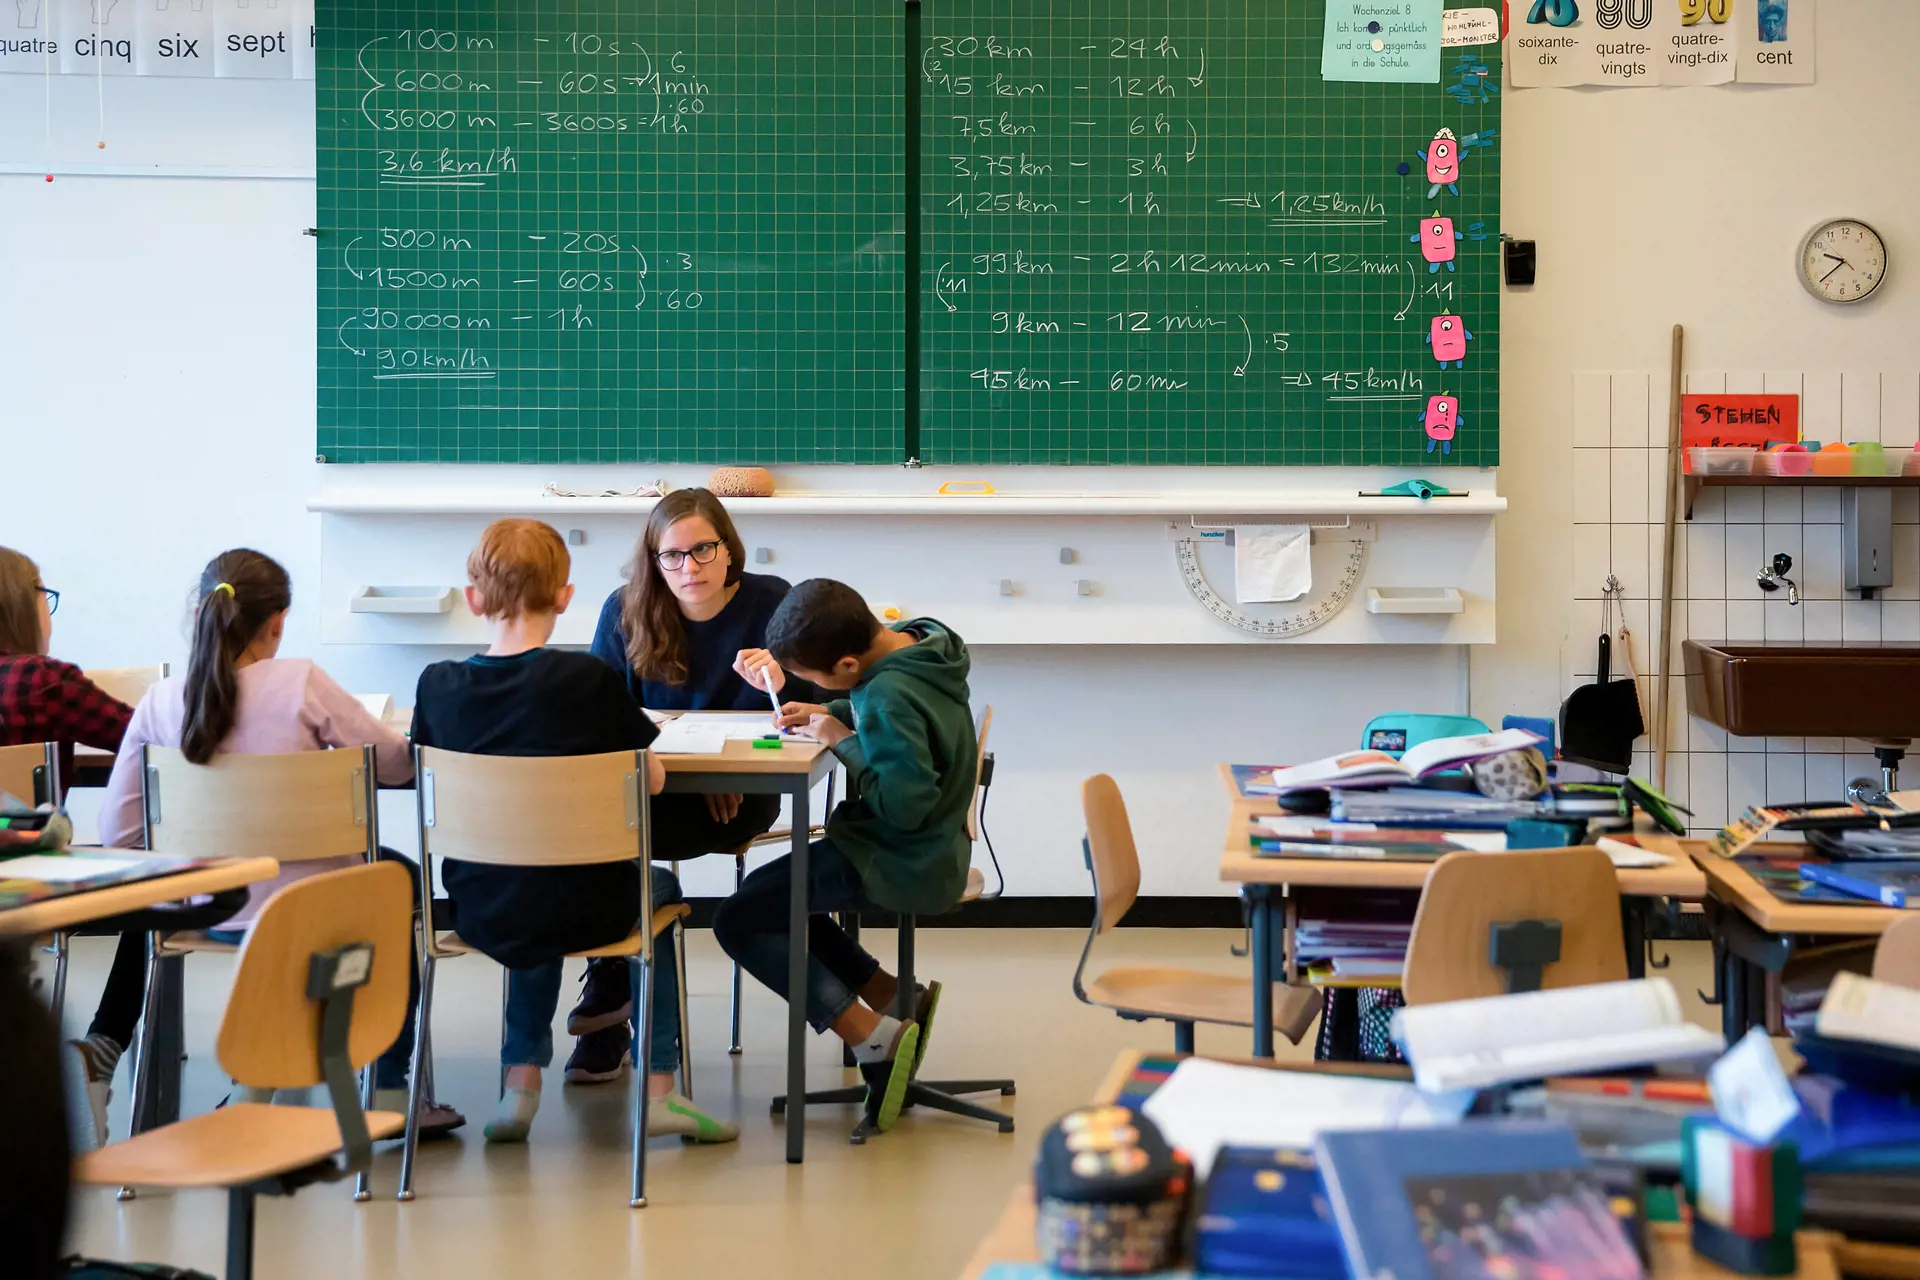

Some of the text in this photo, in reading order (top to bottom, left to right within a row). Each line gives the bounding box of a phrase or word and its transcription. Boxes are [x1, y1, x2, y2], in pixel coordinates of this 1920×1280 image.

[1352, 4, 1412, 16] Wochenziel 8
[1336, 21, 1427, 37] Ich kome pünktlich
[0, 38, 57, 55] quatre
[74, 33, 132, 63] cinq
[158, 32, 200, 58] six
[227, 30, 286, 58] sept
[1336, 40, 1351, 50] und
[1517, 36, 1579, 48] soixante-
[1671, 32, 1724, 48] quatre-
[1595, 42, 1651, 58] quatre-
[1667, 50, 1729, 66] vingt-dix
[1756, 49, 1793, 65] cent
[1351, 56, 1411, 68] in die Schule.
[1538, 52, 1558, 65] dix
[1601, 62, 1646, 78] vingts
[1841, 227, 1850, 235] 12
[1695, 403, 1780, 425] STEHEN
